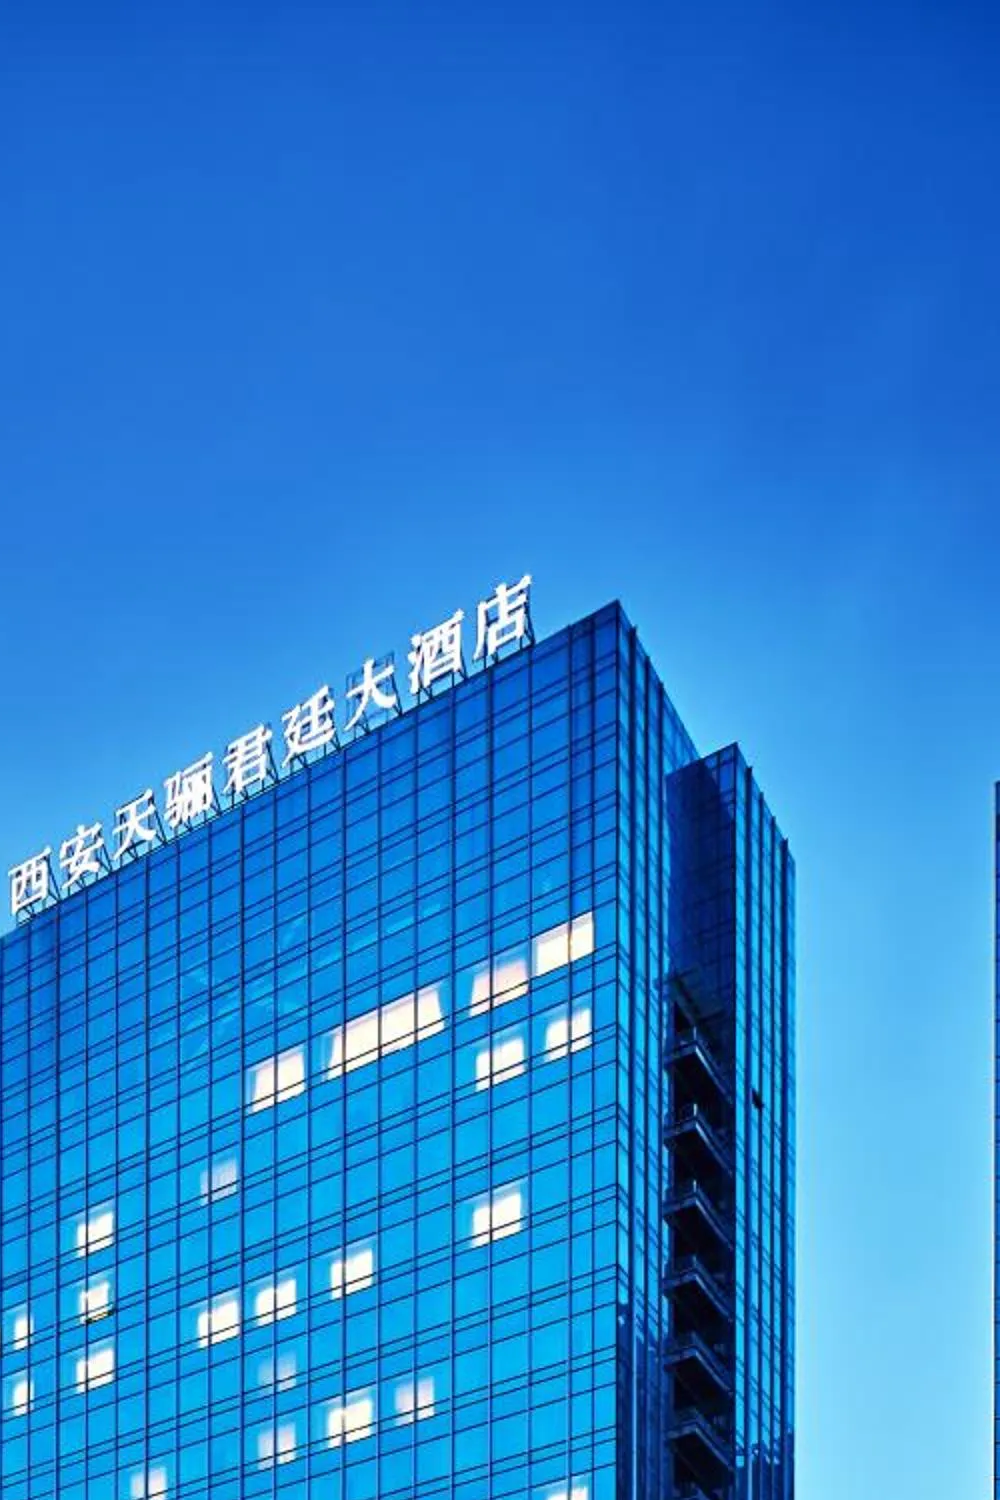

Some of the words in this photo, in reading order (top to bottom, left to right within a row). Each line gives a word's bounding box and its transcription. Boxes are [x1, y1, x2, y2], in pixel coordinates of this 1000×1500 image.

[8, 575, 531, 915] 西安天骊君廷大酒店
